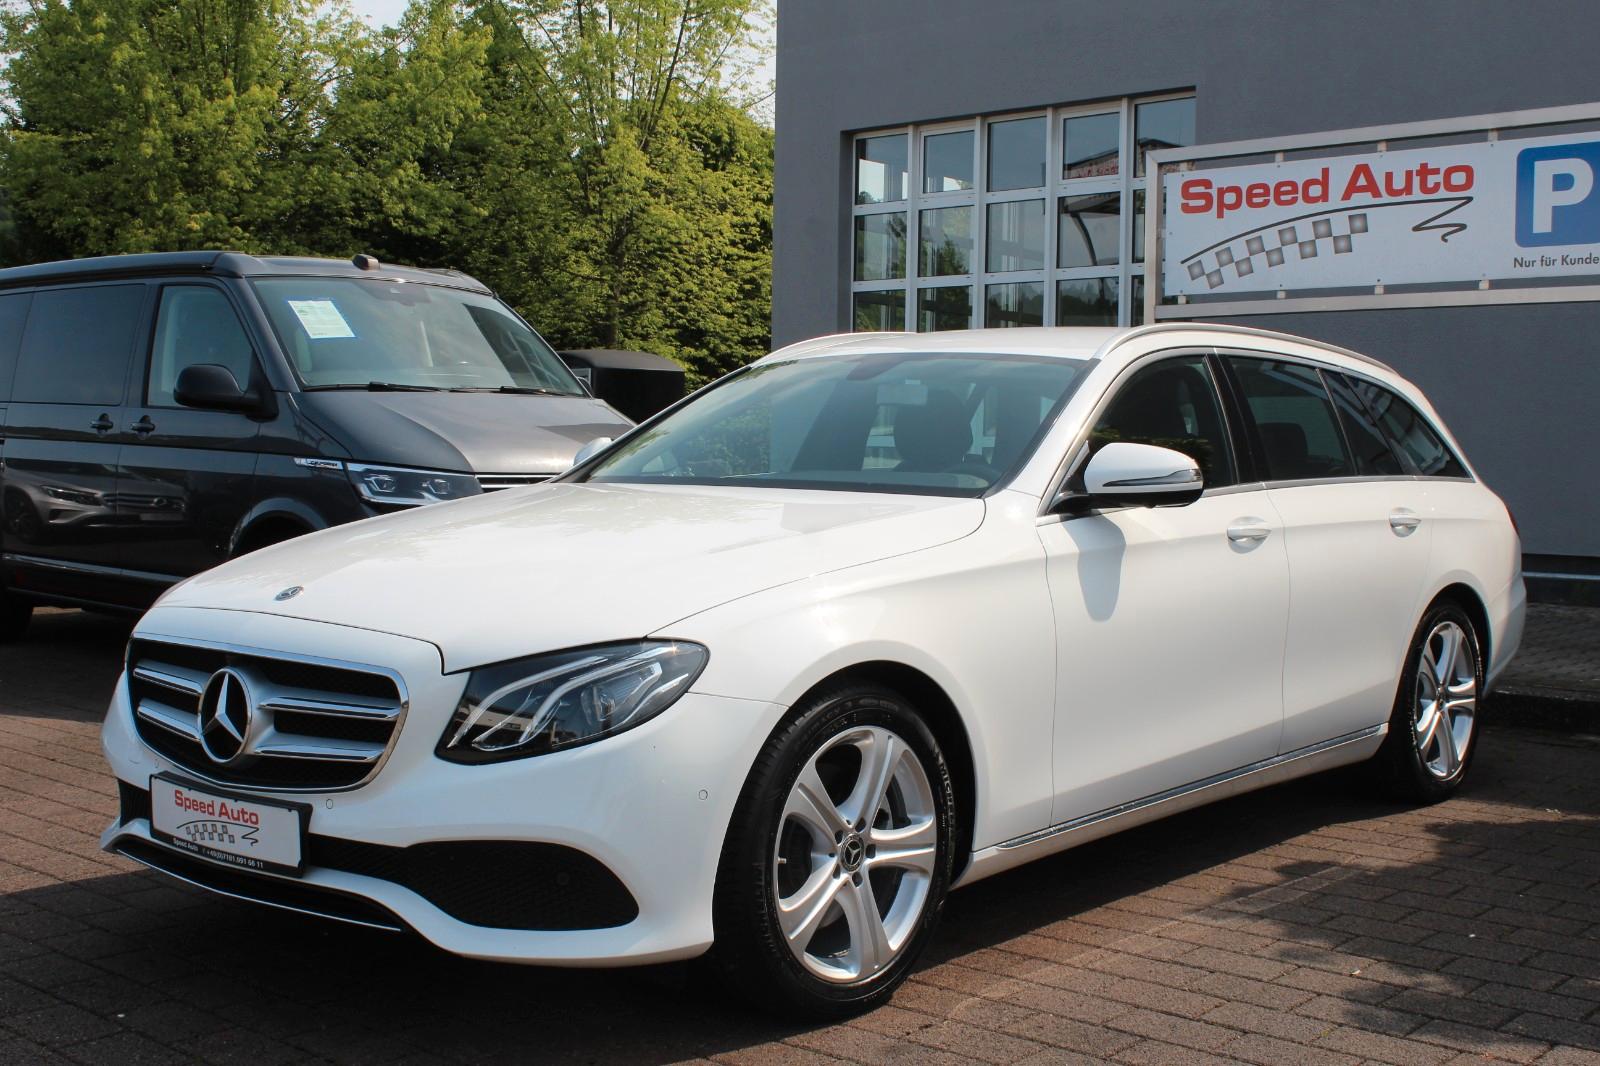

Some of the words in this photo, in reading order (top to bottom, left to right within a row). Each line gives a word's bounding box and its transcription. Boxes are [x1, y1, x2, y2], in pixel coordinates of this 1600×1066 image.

[1180, 167, 1330, 219] Speed
[1341, 163, 1475, 201] Auto
[1532, 157, 1595, 234] P
[1513, 257, 1537, 268] Nur
[1540, 255, 1557, 267] für
[174, 789, 215, 816] Speed
[219, 802, 259, 825] Auto
